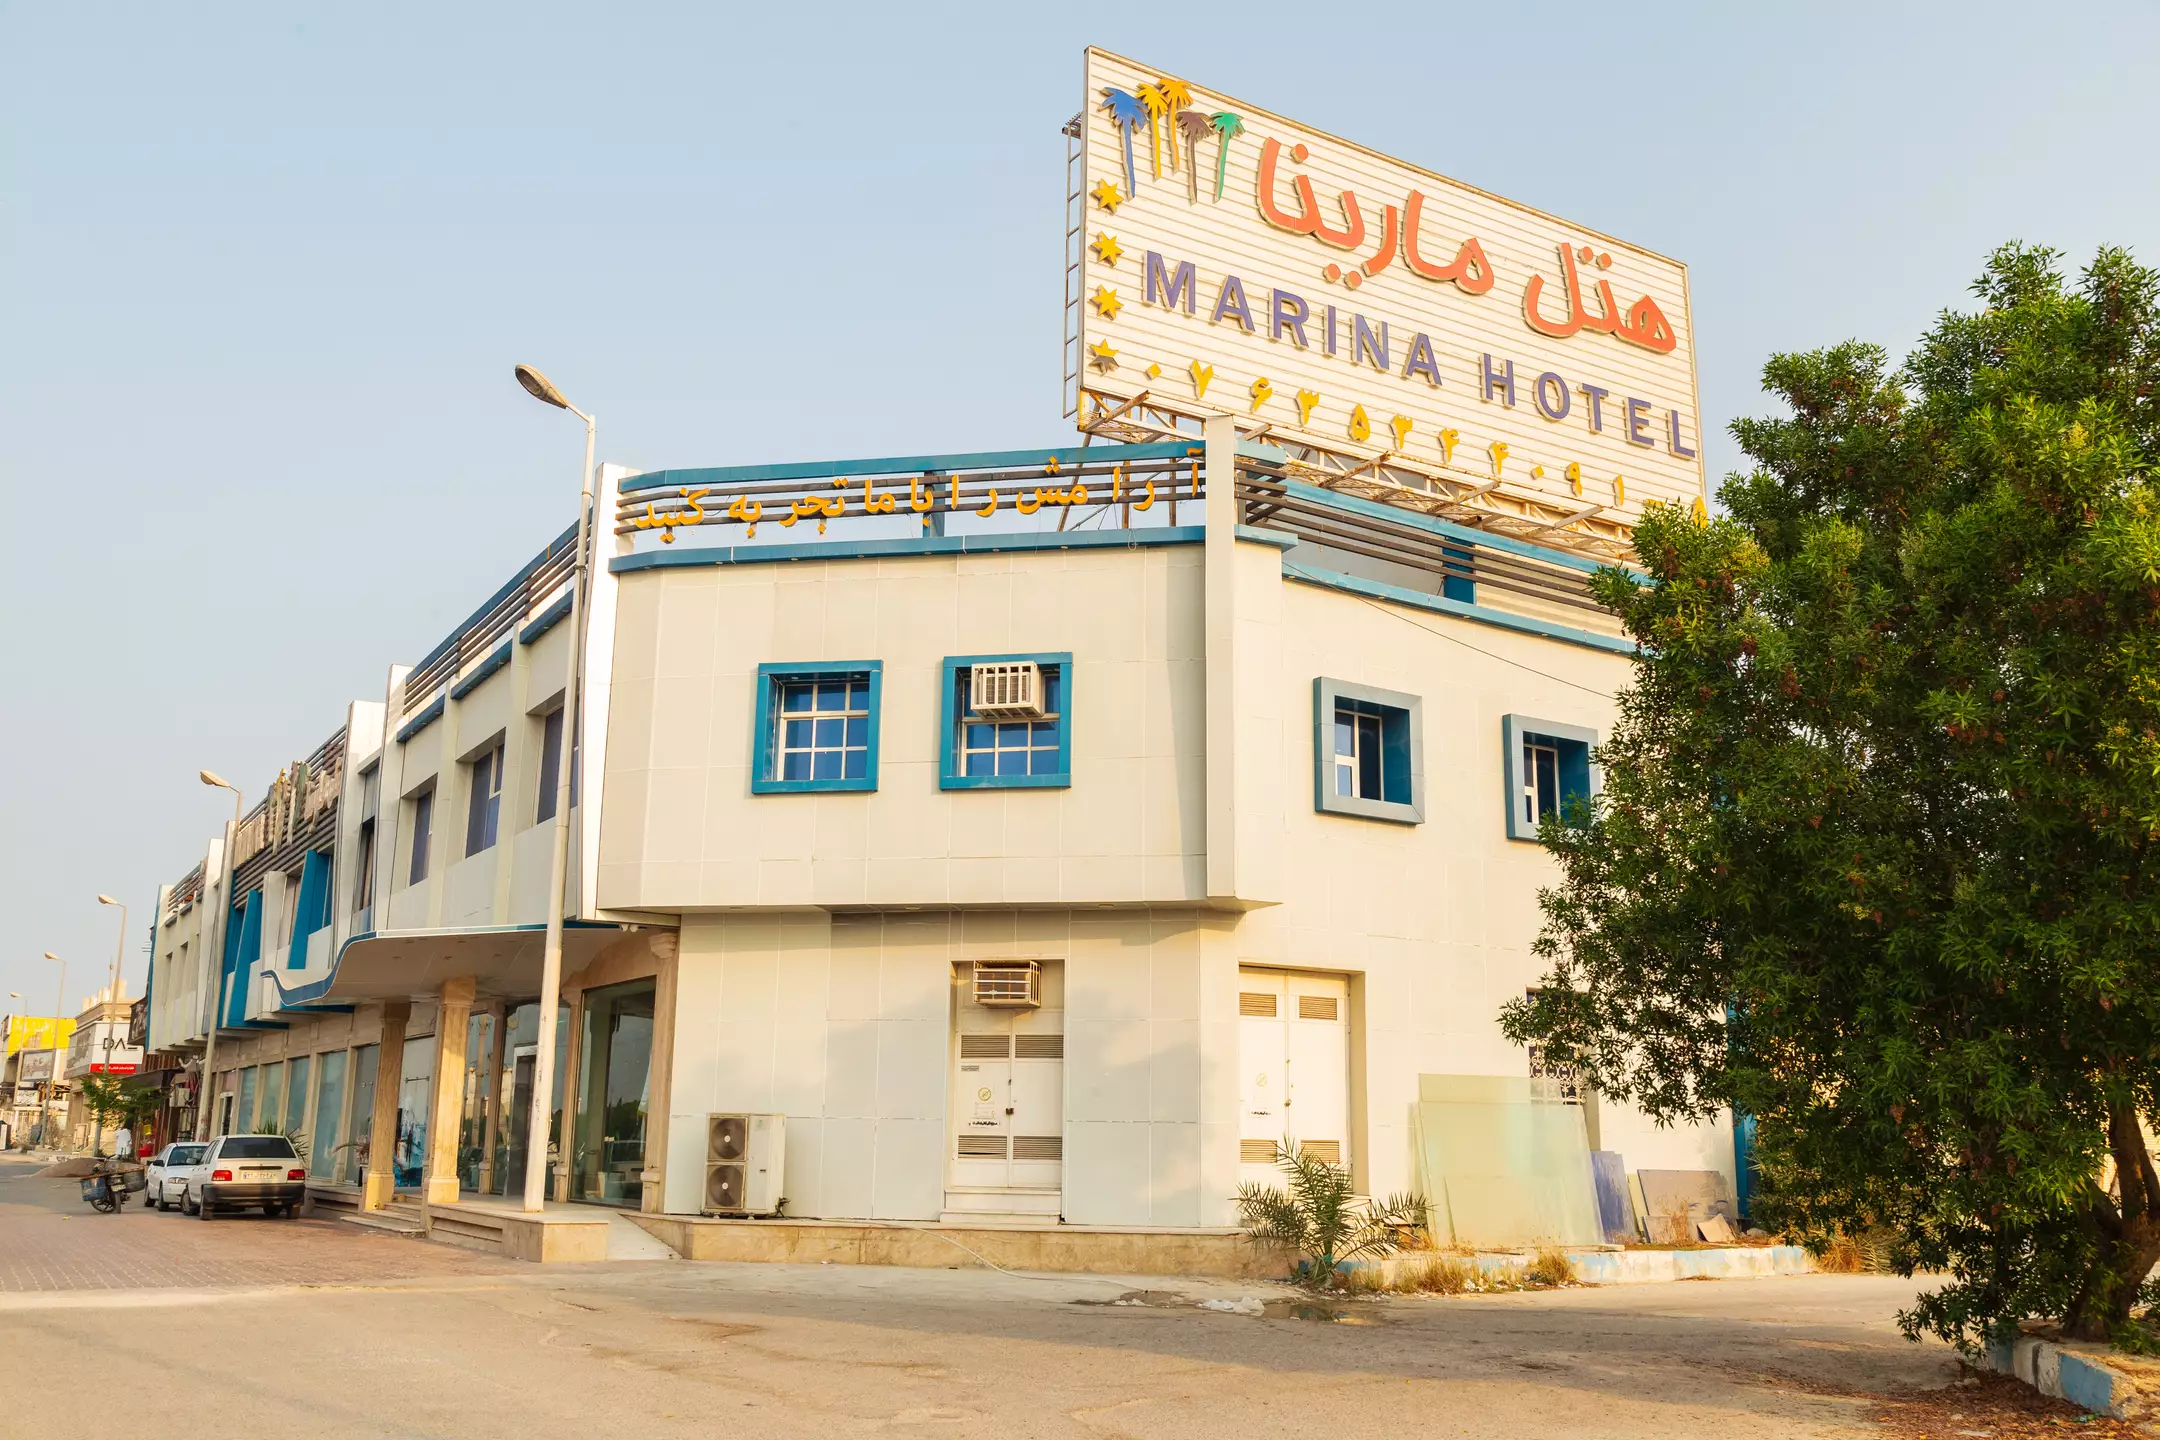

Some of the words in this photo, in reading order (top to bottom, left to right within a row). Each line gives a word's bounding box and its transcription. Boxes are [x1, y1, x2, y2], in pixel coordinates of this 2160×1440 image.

[1257, 136, 1496, 294] مارینا
[1523, 241, 1678, 354] هتل
[1142, 249, 1443, 387] MARINA
[1479, 352, 1697, 460] HOTEL
[635, 486, 710, 544] کنید
[864, 477, 896, 514] ما
